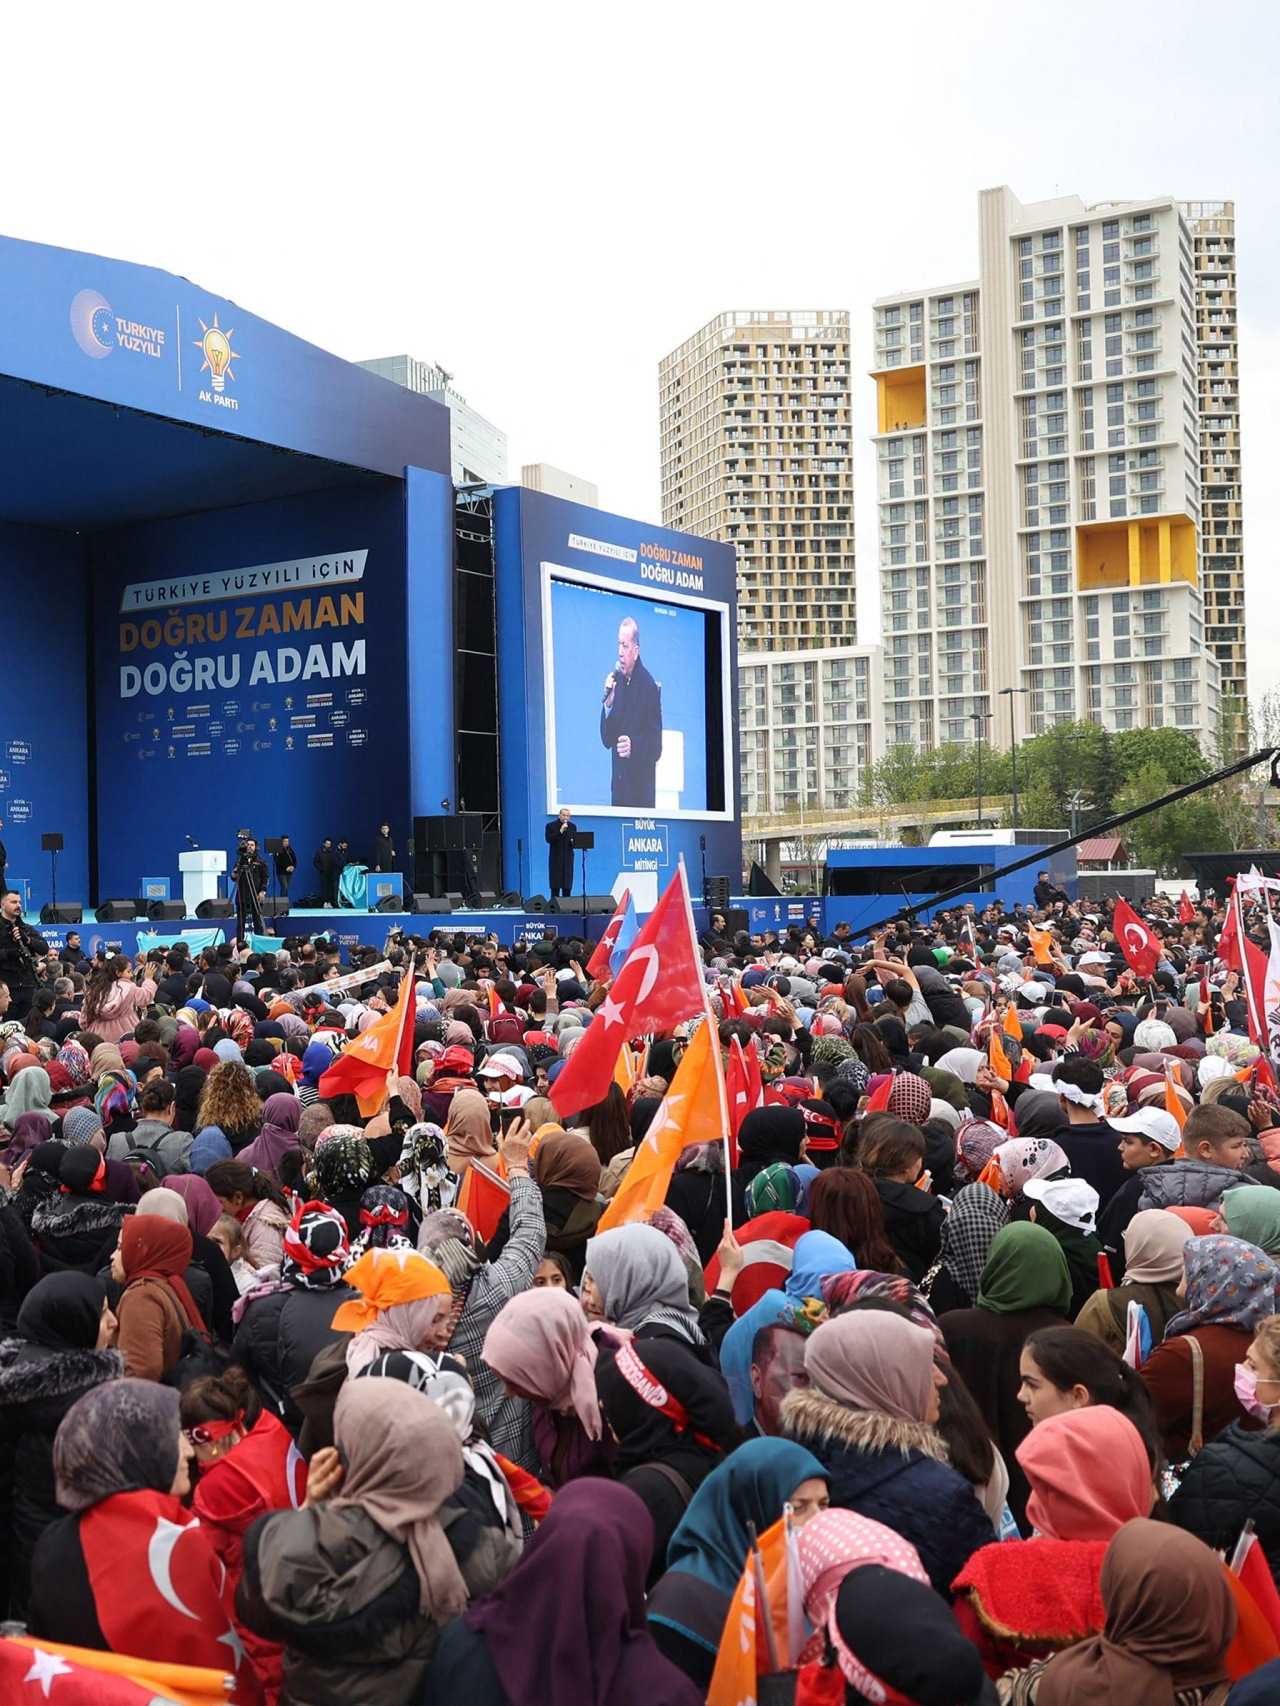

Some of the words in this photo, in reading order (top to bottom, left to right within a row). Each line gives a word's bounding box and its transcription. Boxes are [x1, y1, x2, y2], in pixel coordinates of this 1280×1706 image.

[199, 390, 212, 403] AK
[640, 542, 671, 564] DOĞRU
[671, 550, 703, 571] ZAMAN
[133, 580, 211, 604] TÜRKİYE
[221, 567, 300, 592] YÜZYILI
[312, 558, 355, 580] İÇİN
[640, 562, 674, 585] DOĞRU
[676, 570, 704, 592] ADAM
[120, 608, 229, 652] DOĞRU
[235, 591, 365, 639] ZAMAN
[120, 651, 241, 698] DOĞRU
[249, 639, 366, 686] ADAM
[634, 817, 656, 831] BÜYÜK
[628, 838, 664, 852] ANKARA
